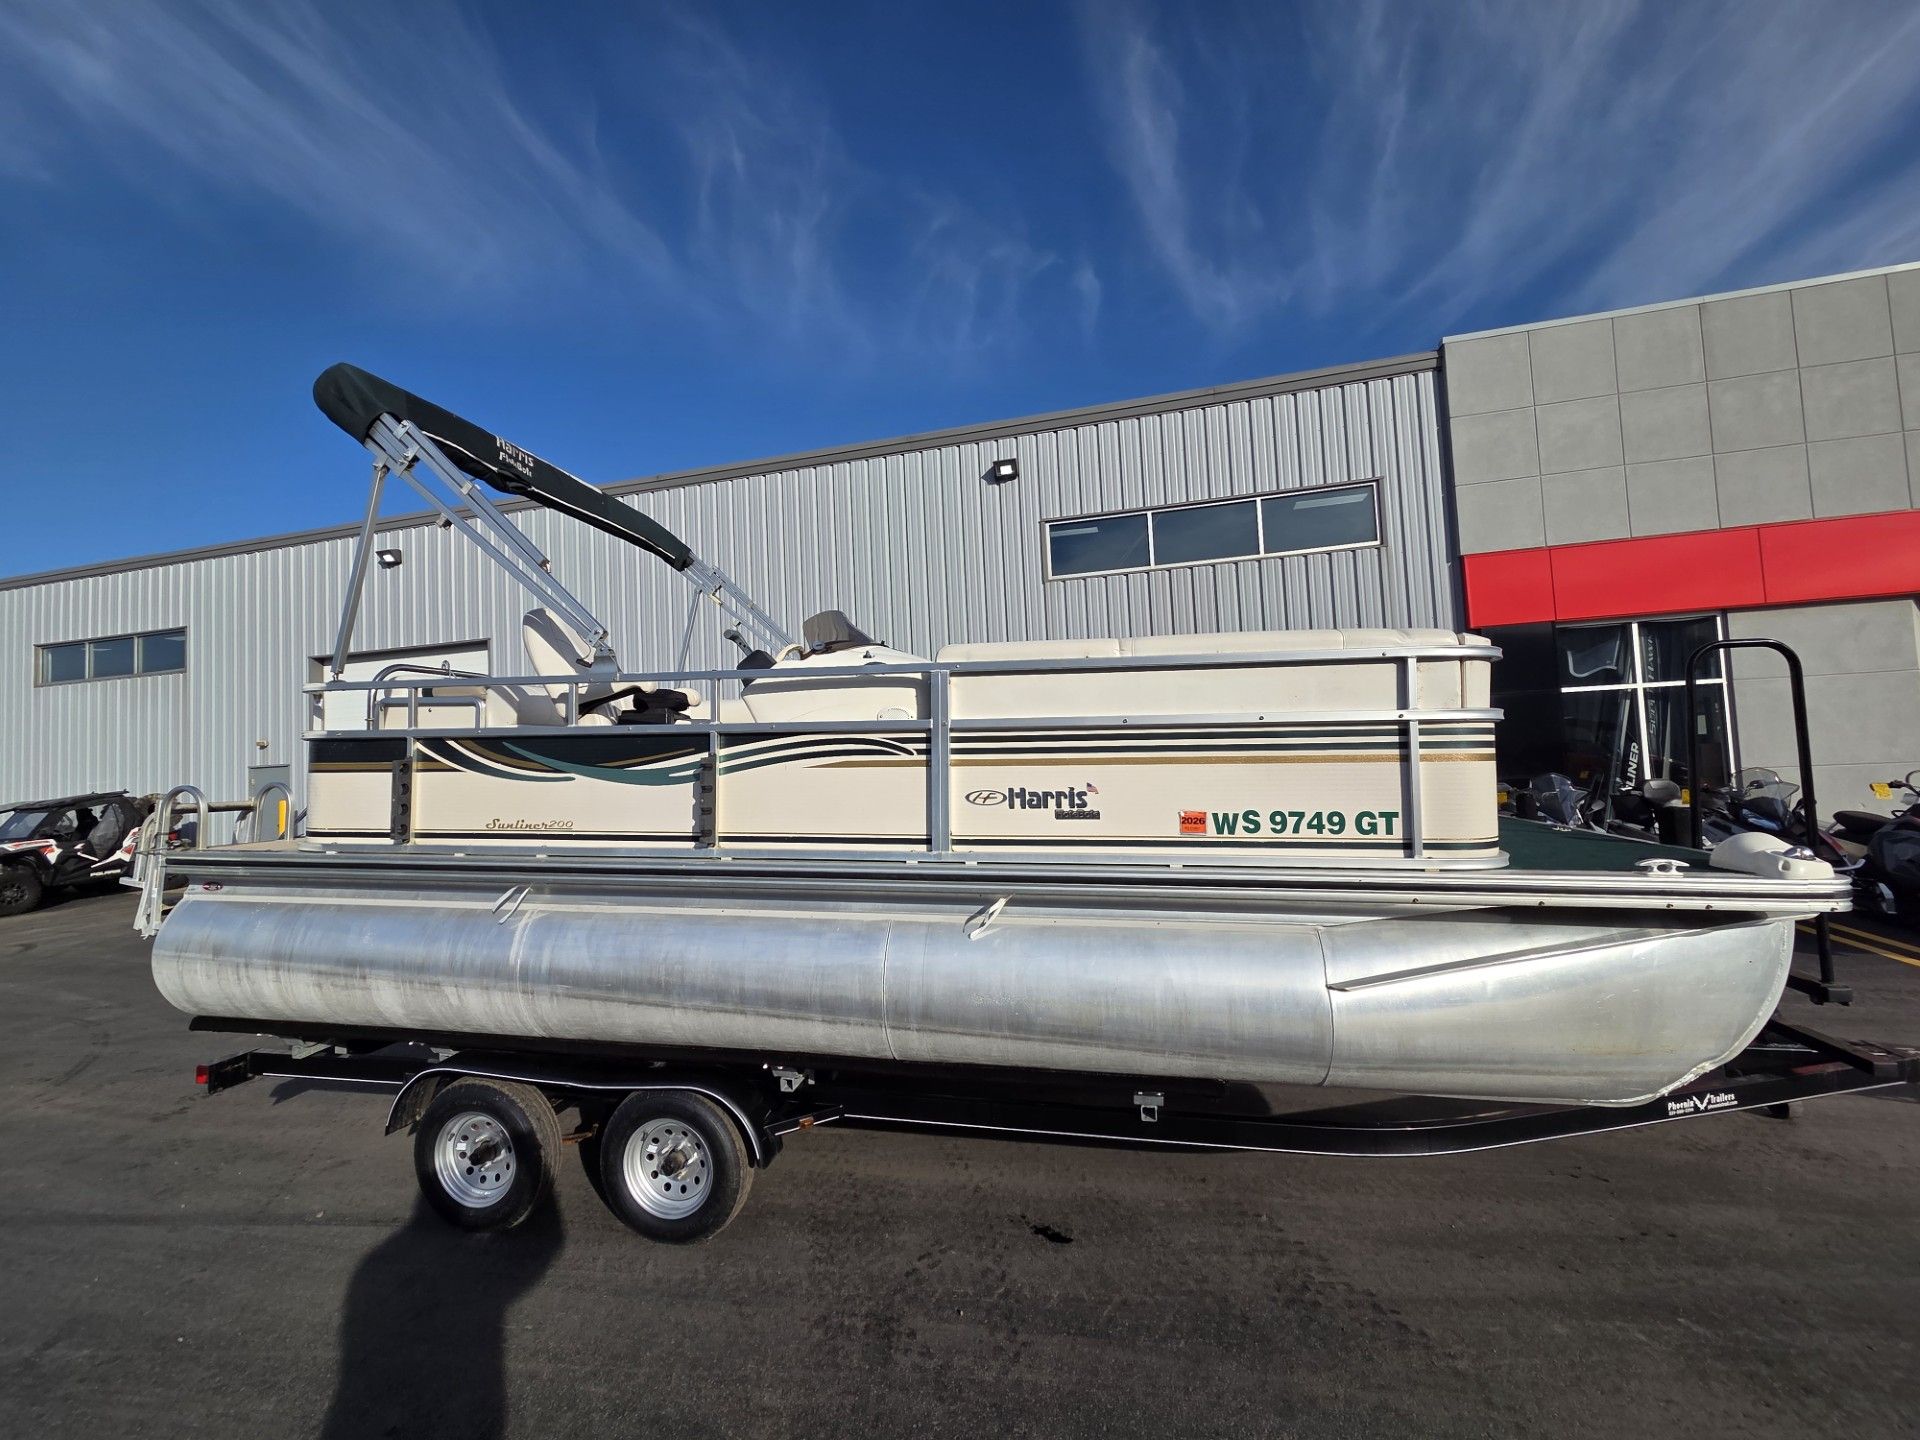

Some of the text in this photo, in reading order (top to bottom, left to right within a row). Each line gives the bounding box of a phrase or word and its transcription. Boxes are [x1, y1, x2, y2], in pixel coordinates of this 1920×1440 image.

[496, 436, 534, 467] Harris
[1625, 742, 1639, 789] LINER
[1007, 786, 1088, 809] Harris
[1181, 816, 1206, 825] 2026
[1211, 809, 1399, 835] WS 9749 GT
[1710, 1092, 1735, 1104] Trailers
